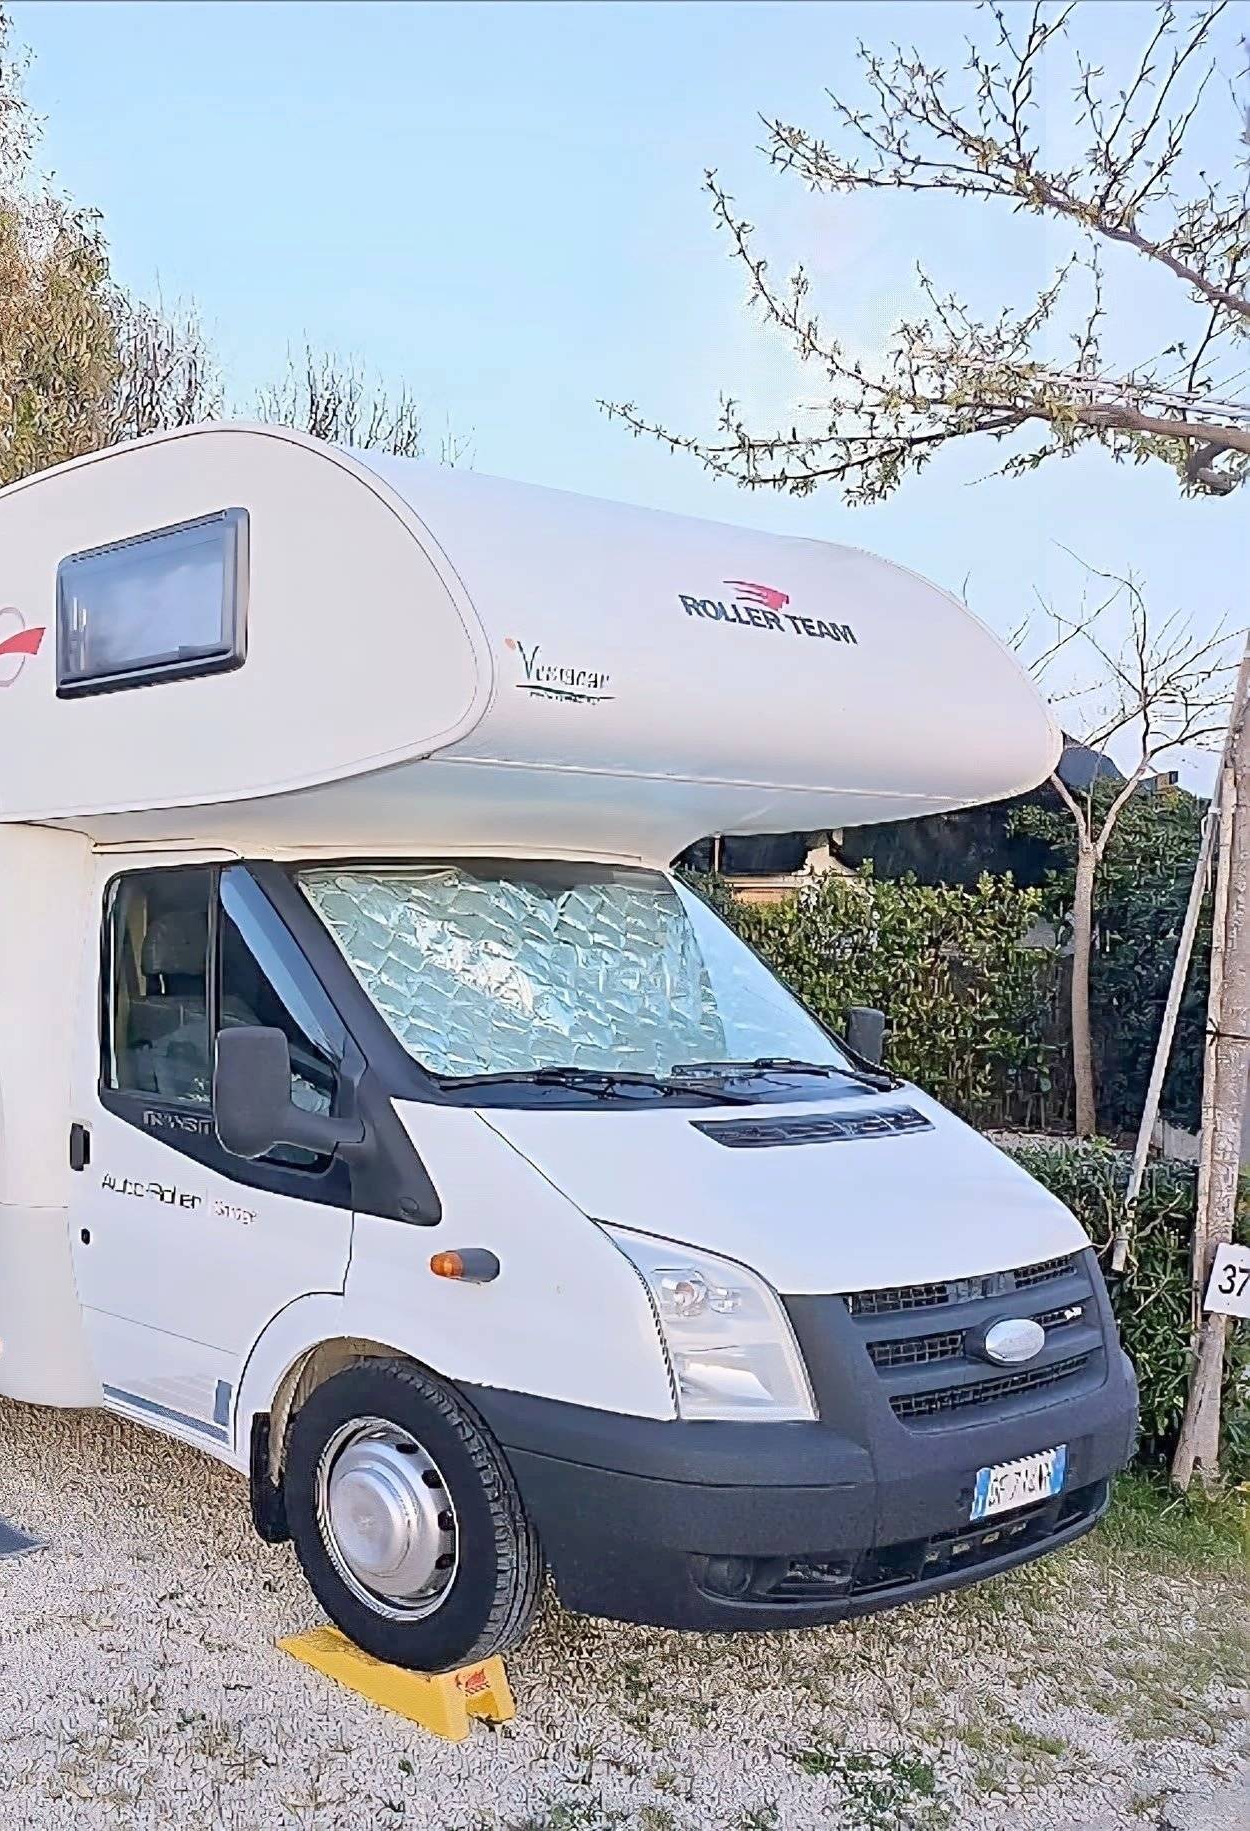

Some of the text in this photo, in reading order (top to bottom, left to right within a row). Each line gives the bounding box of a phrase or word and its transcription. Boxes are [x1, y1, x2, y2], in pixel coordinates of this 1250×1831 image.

[678, 594, 858, 645] ROLLER TEAM
[1217, 1264, 1250, 1297] 37
